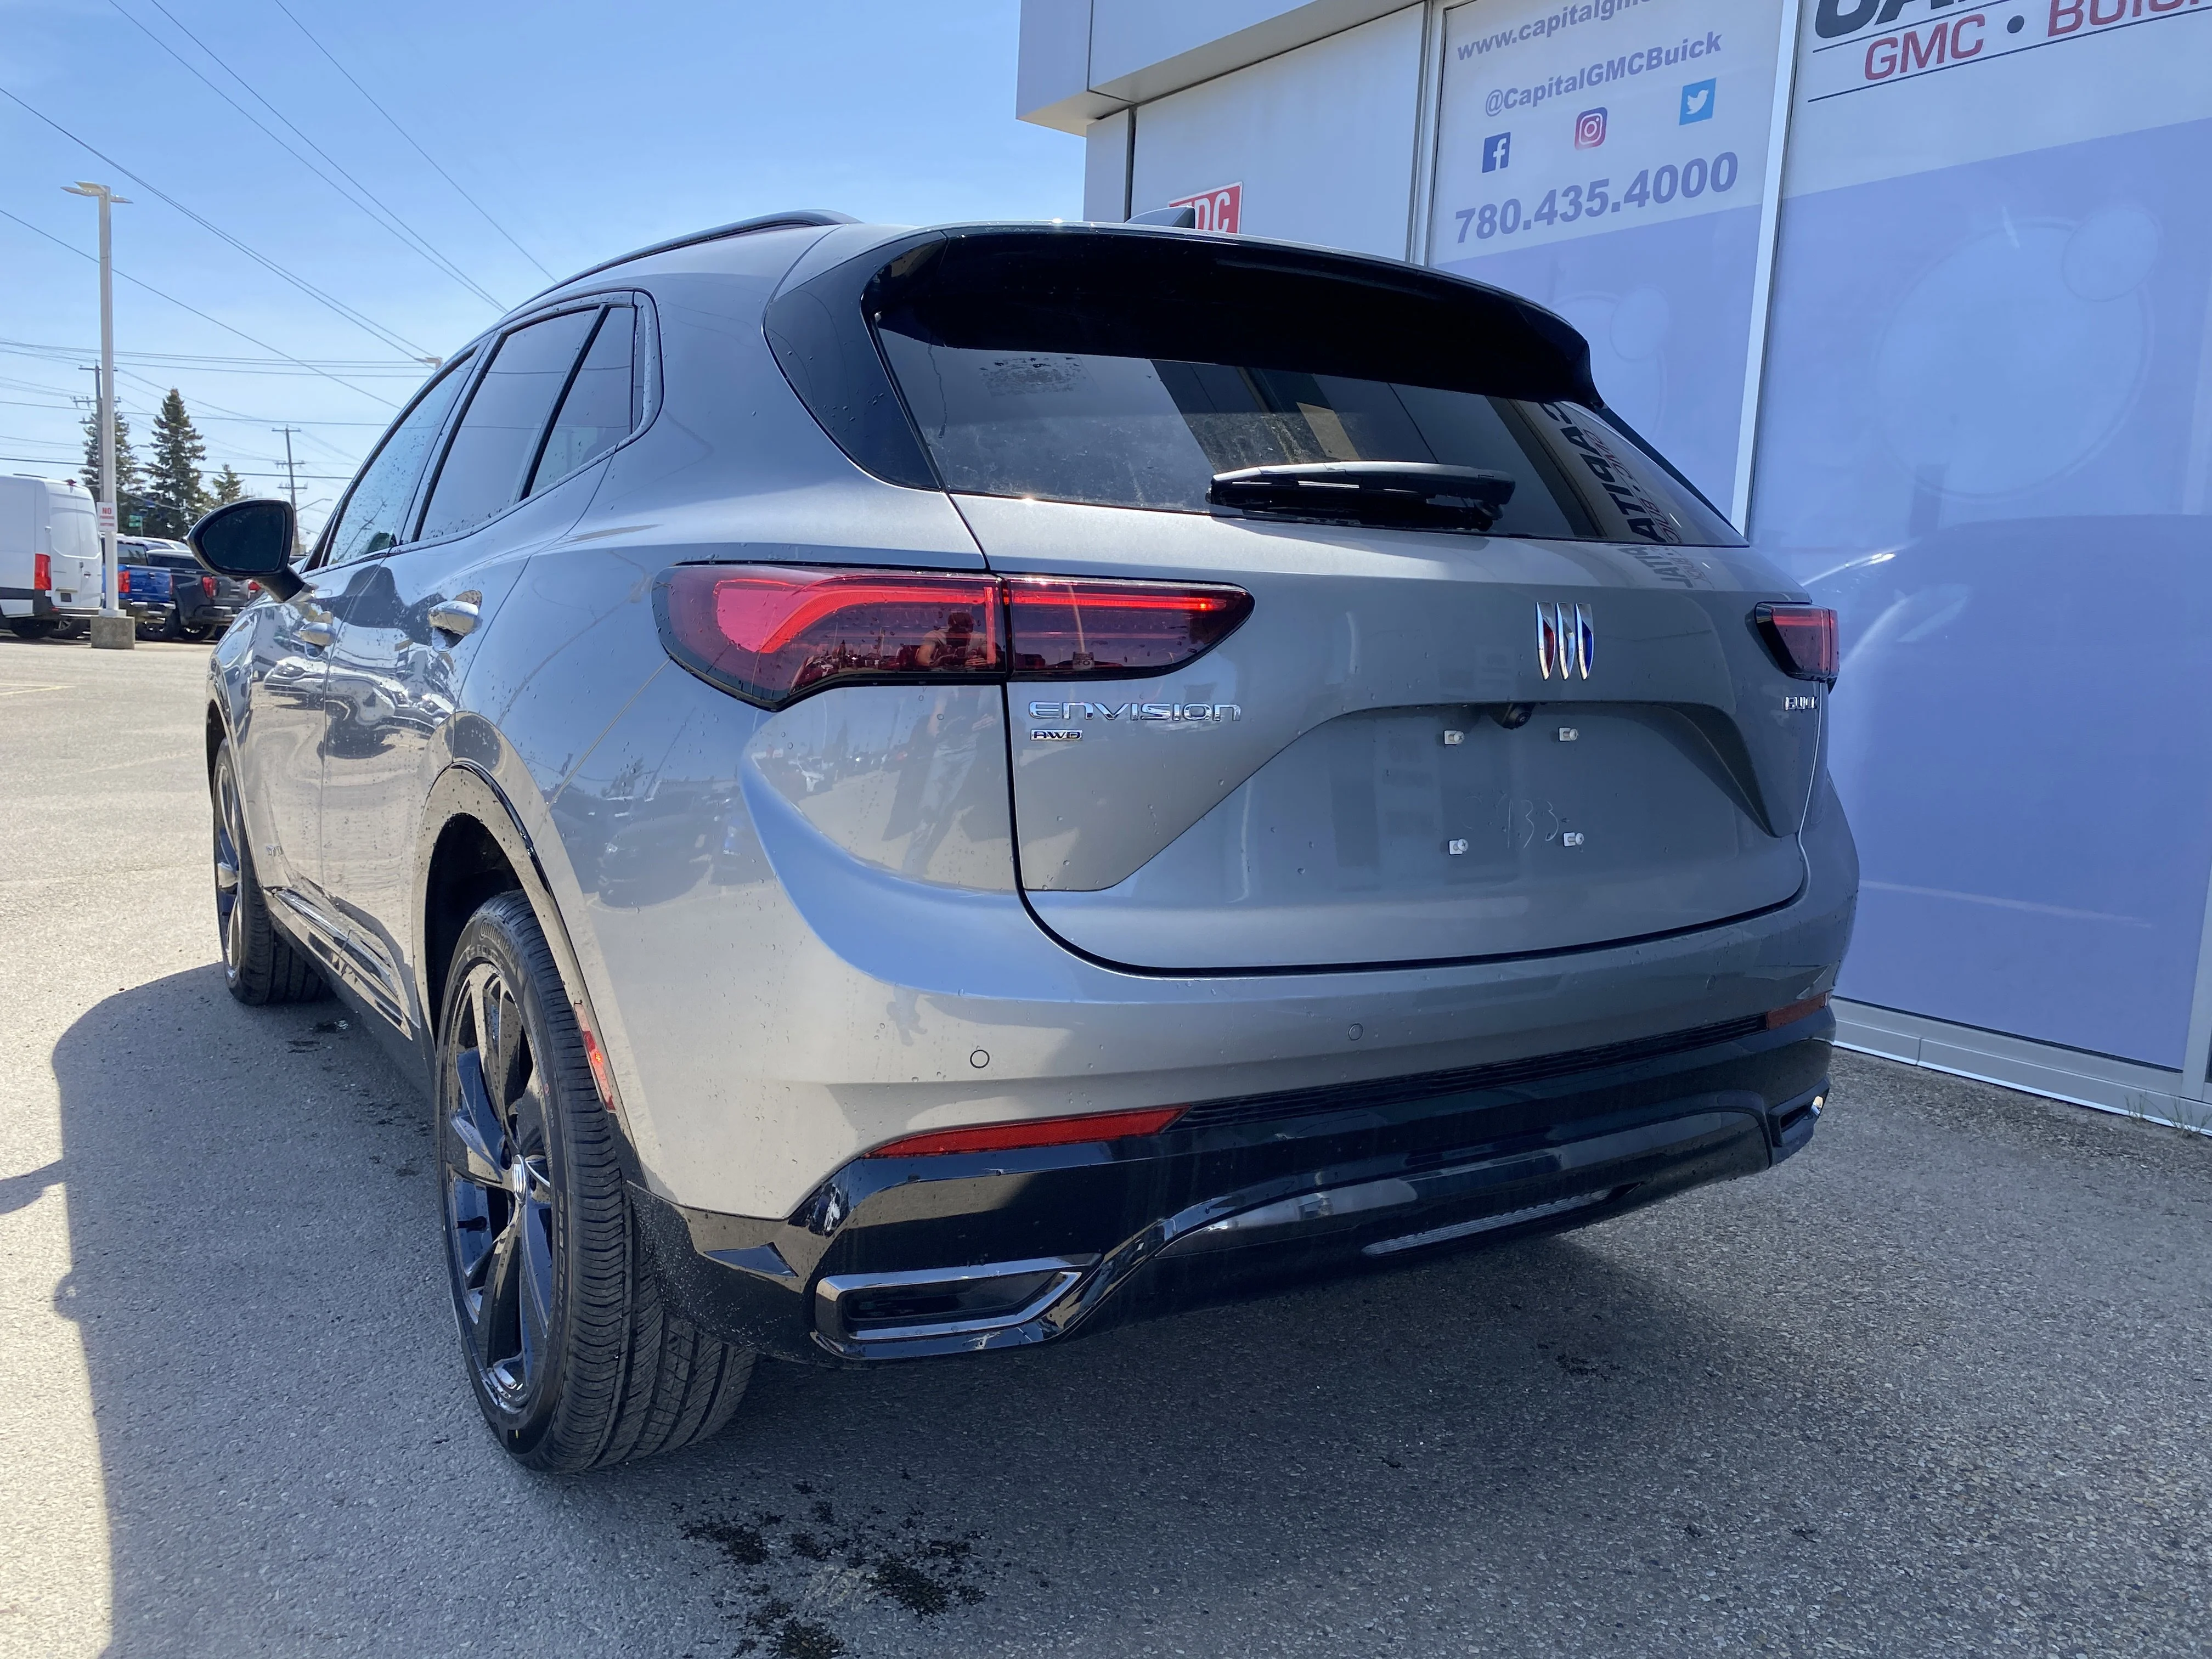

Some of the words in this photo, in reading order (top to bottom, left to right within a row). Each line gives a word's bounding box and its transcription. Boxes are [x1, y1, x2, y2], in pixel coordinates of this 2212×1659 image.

[1457, 0, 1650, 60] www.capitalg
[1865, 14, 1985, 80] GMC
[1485, 31, 1722, 117] @CapitalGMCBuick
[1176, 191, 1231, 232] DC
[1455, 151, 1739, 244] 780.435.4000
[1032, 730, 1082, 740] AWD
